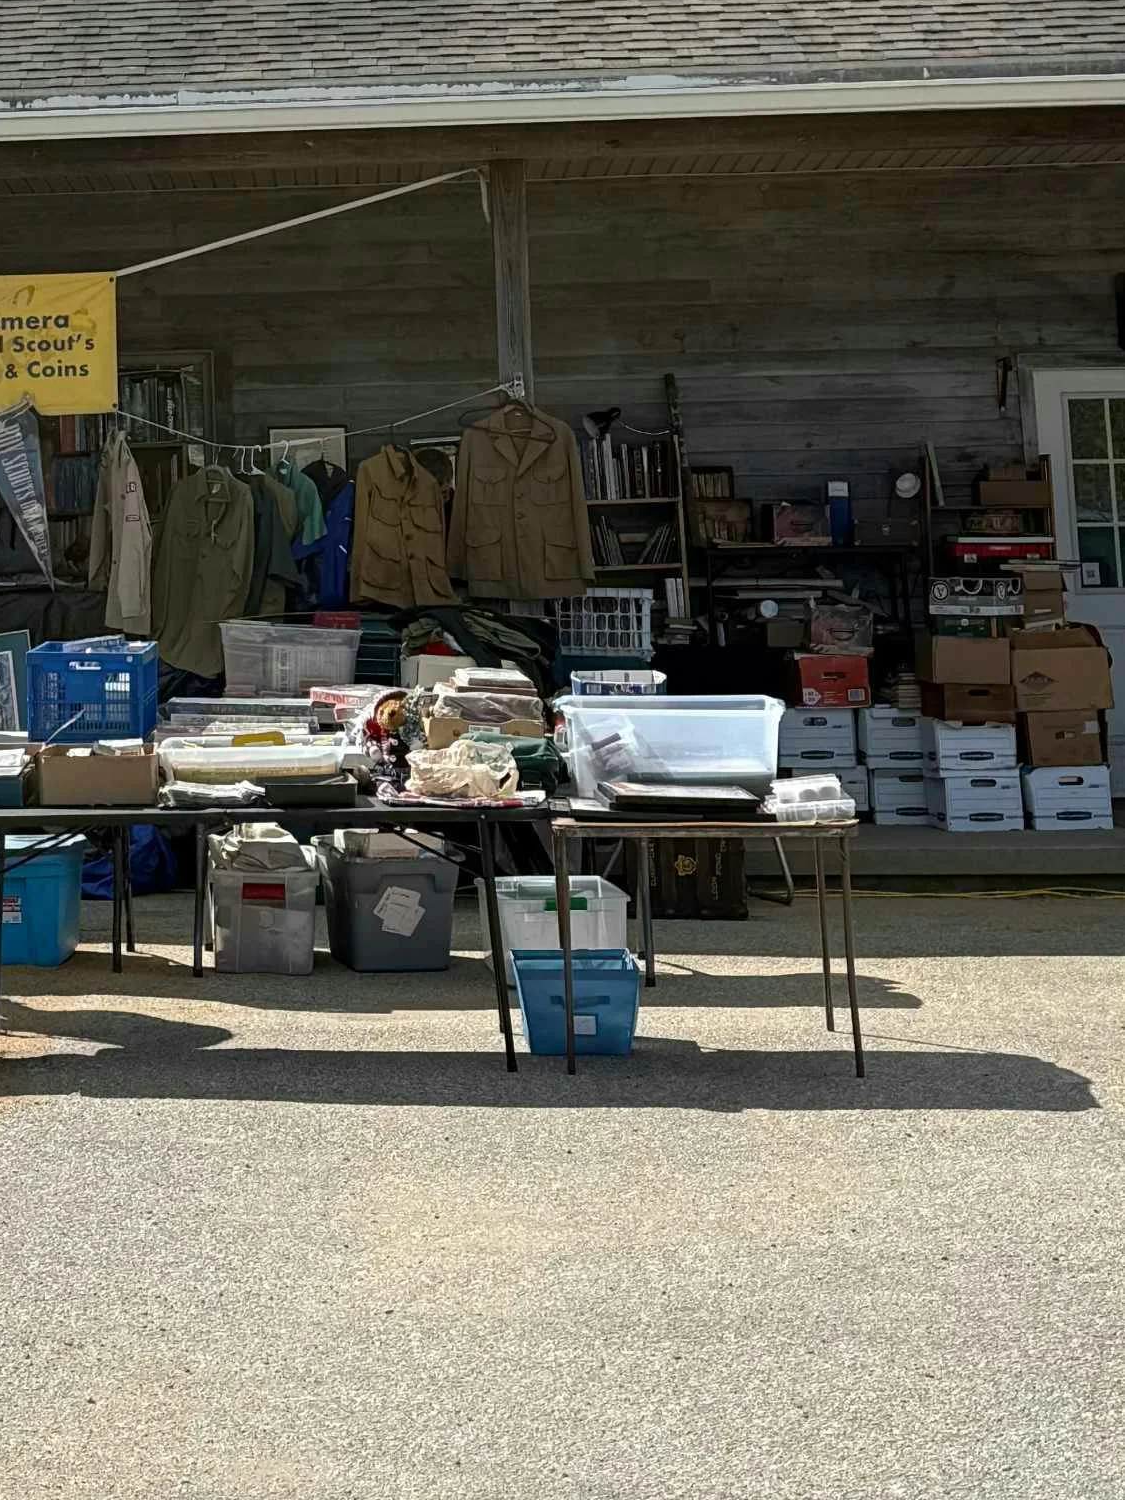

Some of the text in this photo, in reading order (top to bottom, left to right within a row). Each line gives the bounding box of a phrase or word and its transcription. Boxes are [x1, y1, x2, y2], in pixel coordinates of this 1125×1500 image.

[11, 334, 96, 354] Scout's
[4, 363, 19, 379] &
[24, 360, 90, 379] Coins
